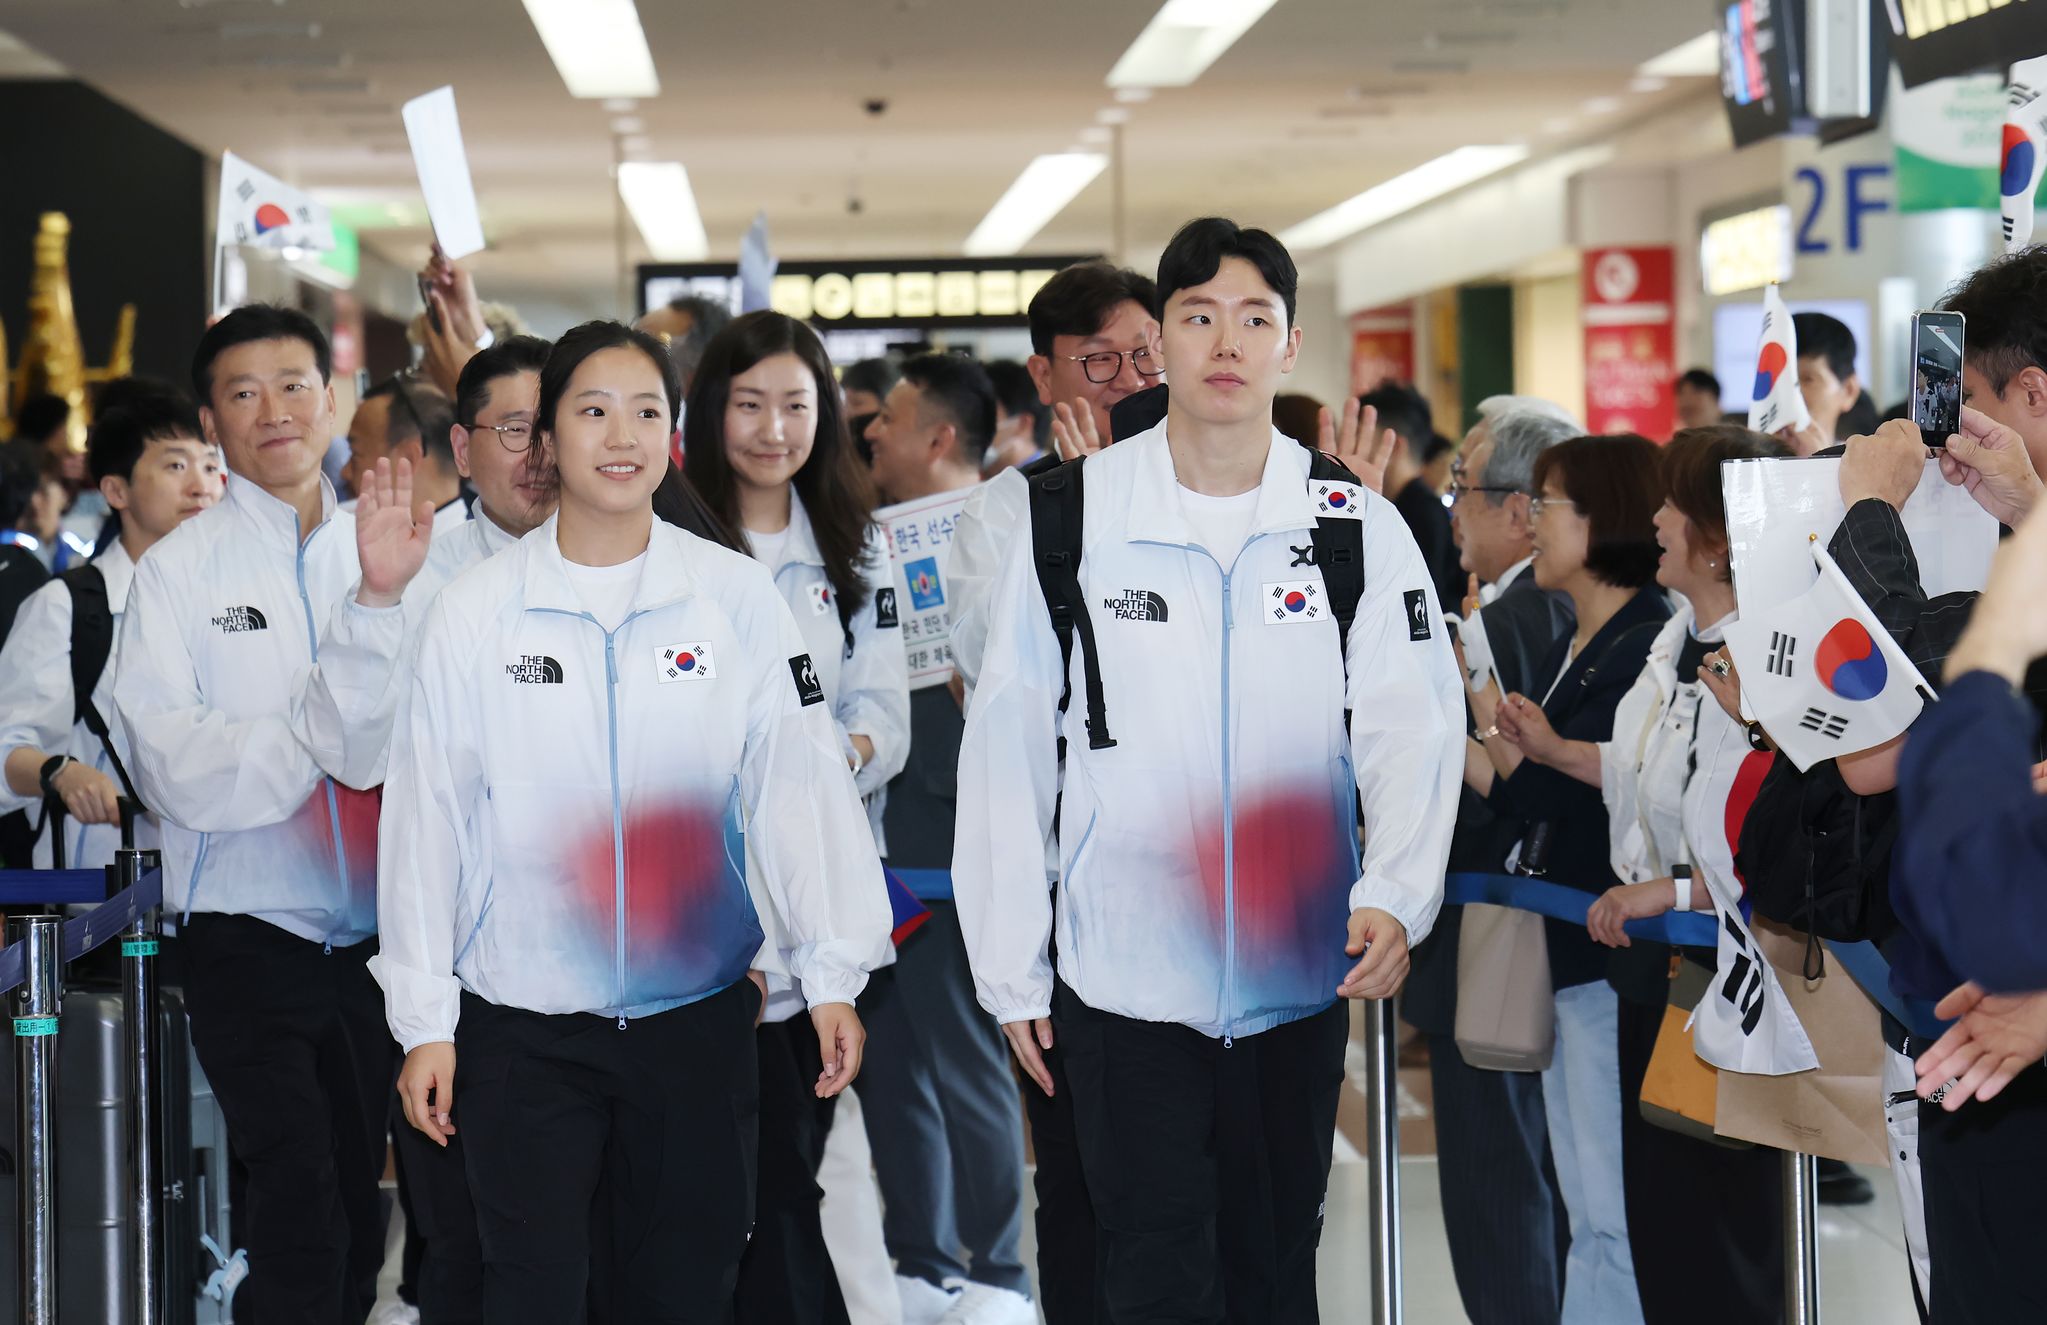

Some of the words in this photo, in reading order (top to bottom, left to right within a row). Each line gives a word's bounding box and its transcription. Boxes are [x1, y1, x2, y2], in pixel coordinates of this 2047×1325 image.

[1794, 163, 1891, 255] 2F
[926, 513, 961, 545] 선수
[1122, 589, 1147, 601] THE
[1104, 598, 1146, 611] NORTH
[225, 606, 246, 616] THE
[1115, 609, 1145, 621] FACE
[211, 614, 247, 626] NORTH
[222, 622, 249, 634] FACE
[520, 655, 543, 665] THE
[505, 664, 543, 675] NORTH
[514, 674, 542, 684] FACE
